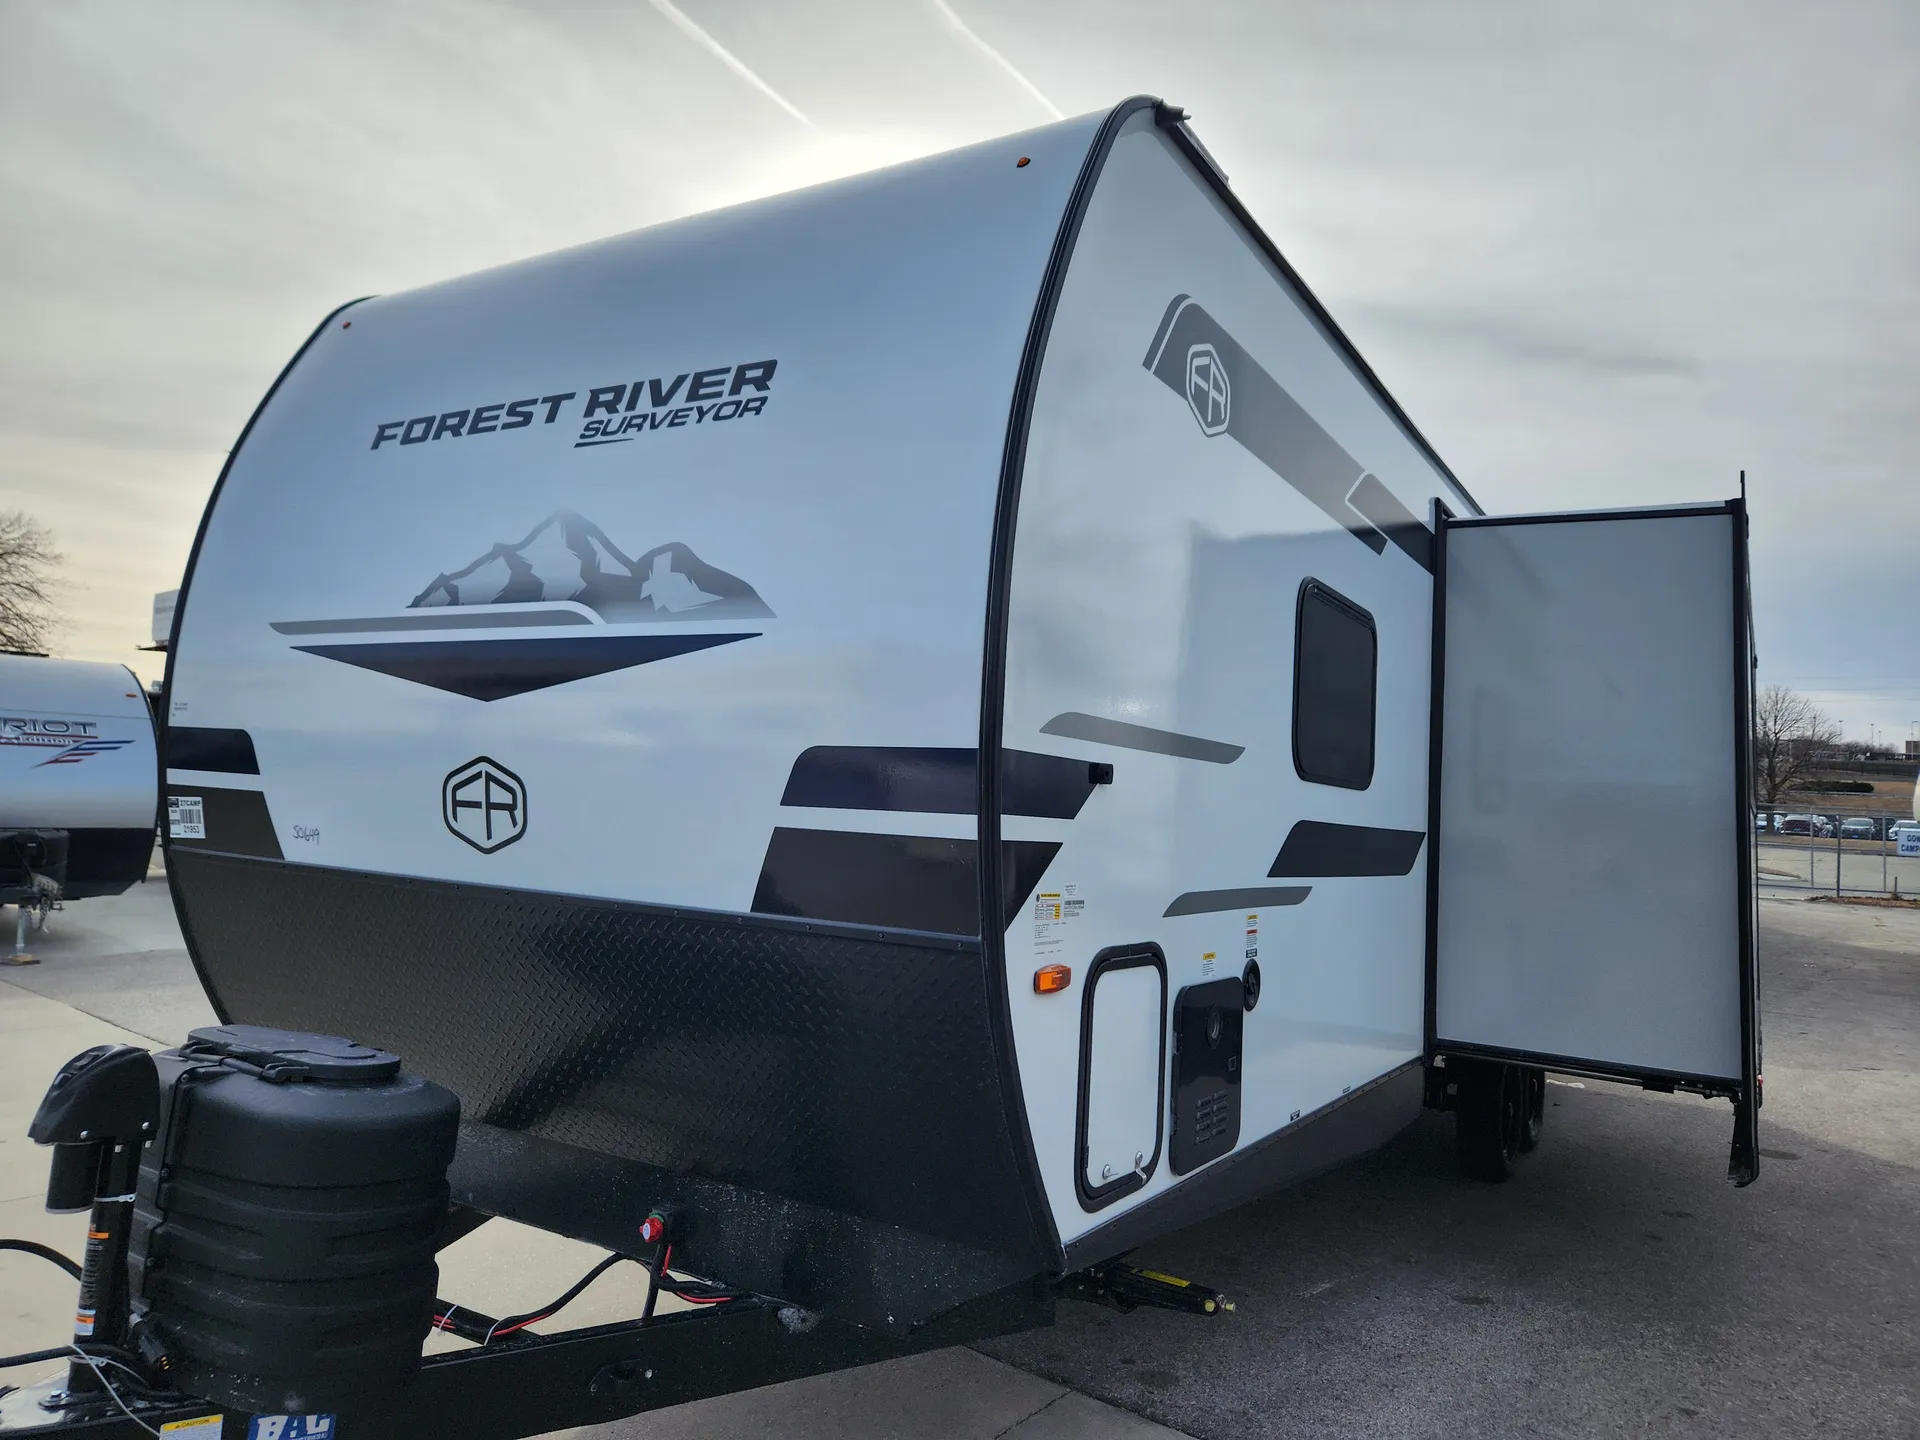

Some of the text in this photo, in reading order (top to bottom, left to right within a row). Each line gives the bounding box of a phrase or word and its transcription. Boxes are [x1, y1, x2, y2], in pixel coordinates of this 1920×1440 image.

[370, 359, 778, 450] FOREST RIVER
[578, 396, 769, 441] SURVEYOR
